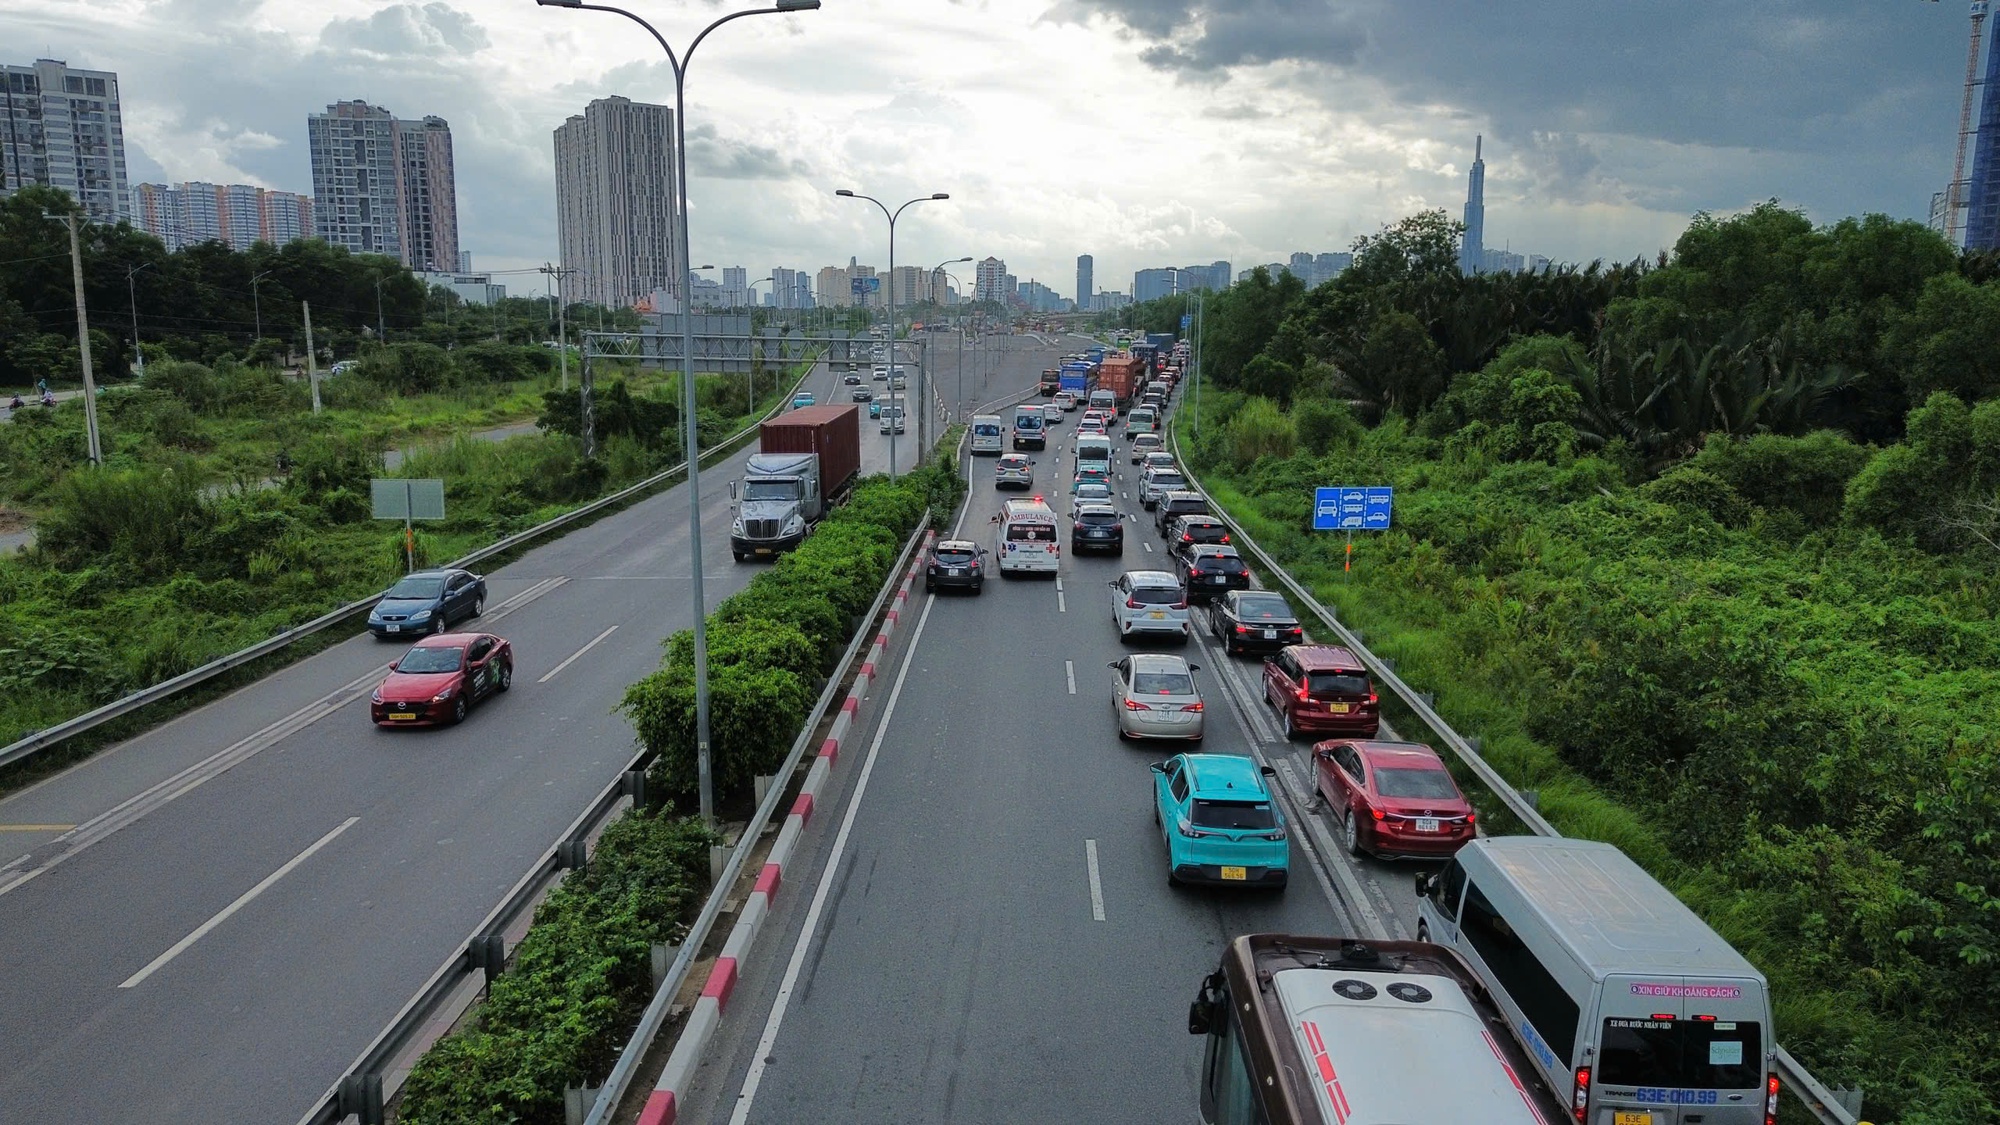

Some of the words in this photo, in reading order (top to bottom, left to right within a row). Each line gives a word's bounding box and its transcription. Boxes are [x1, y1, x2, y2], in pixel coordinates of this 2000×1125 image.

[1011, 513, 1054, 523] AMBULANCE
[1639, 986, 1653, 995] XIN
[1654, 985, 1671, 996] GIỮ
[1671, 986, 1709, 997] KHOẢNG
[1709, 987, 1733, 998] CÁCH
[1625, 1114, 1642, 1123] 63E
